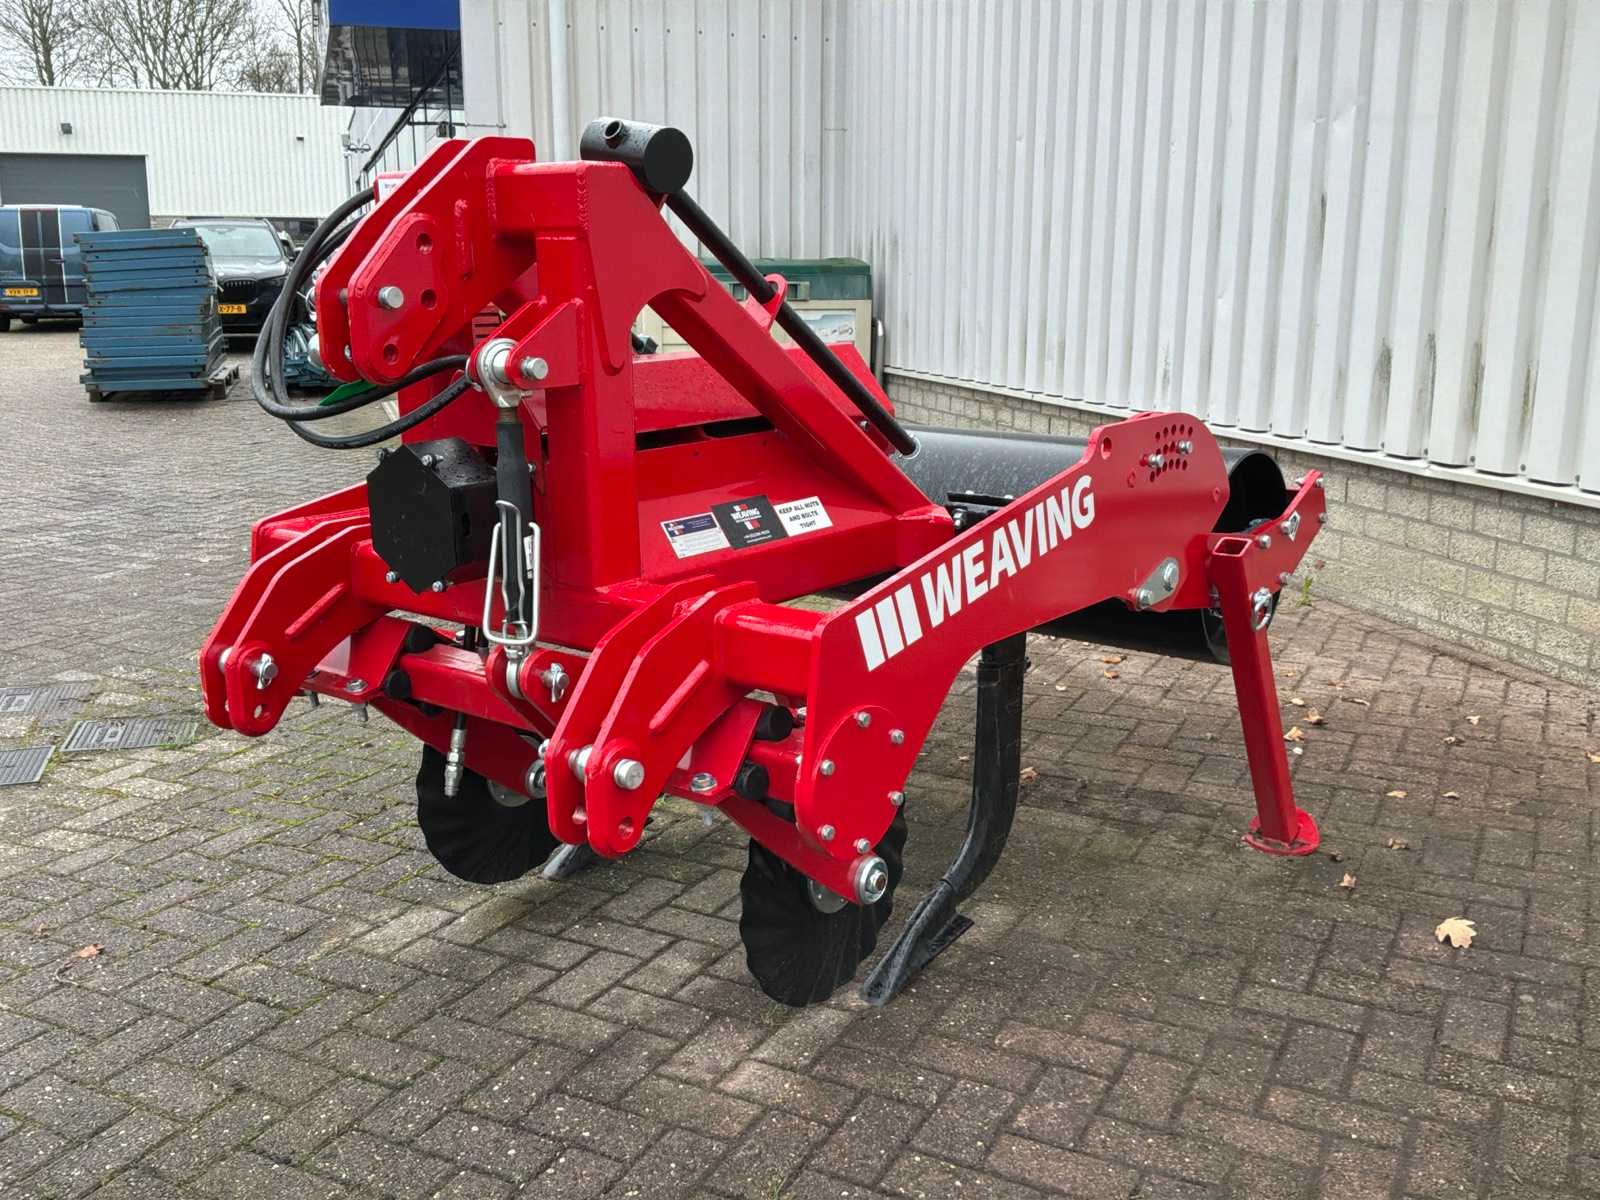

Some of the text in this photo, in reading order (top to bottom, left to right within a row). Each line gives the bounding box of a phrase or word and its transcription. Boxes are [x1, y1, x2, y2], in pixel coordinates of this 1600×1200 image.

[779, 500, 820, 514] KEEP ALL NUTS
[789, 510, 819, 522] AND BOLTS
[799, 519, 817, 529] TIGHT
[921, 474, 1096, 629] WEAVING
